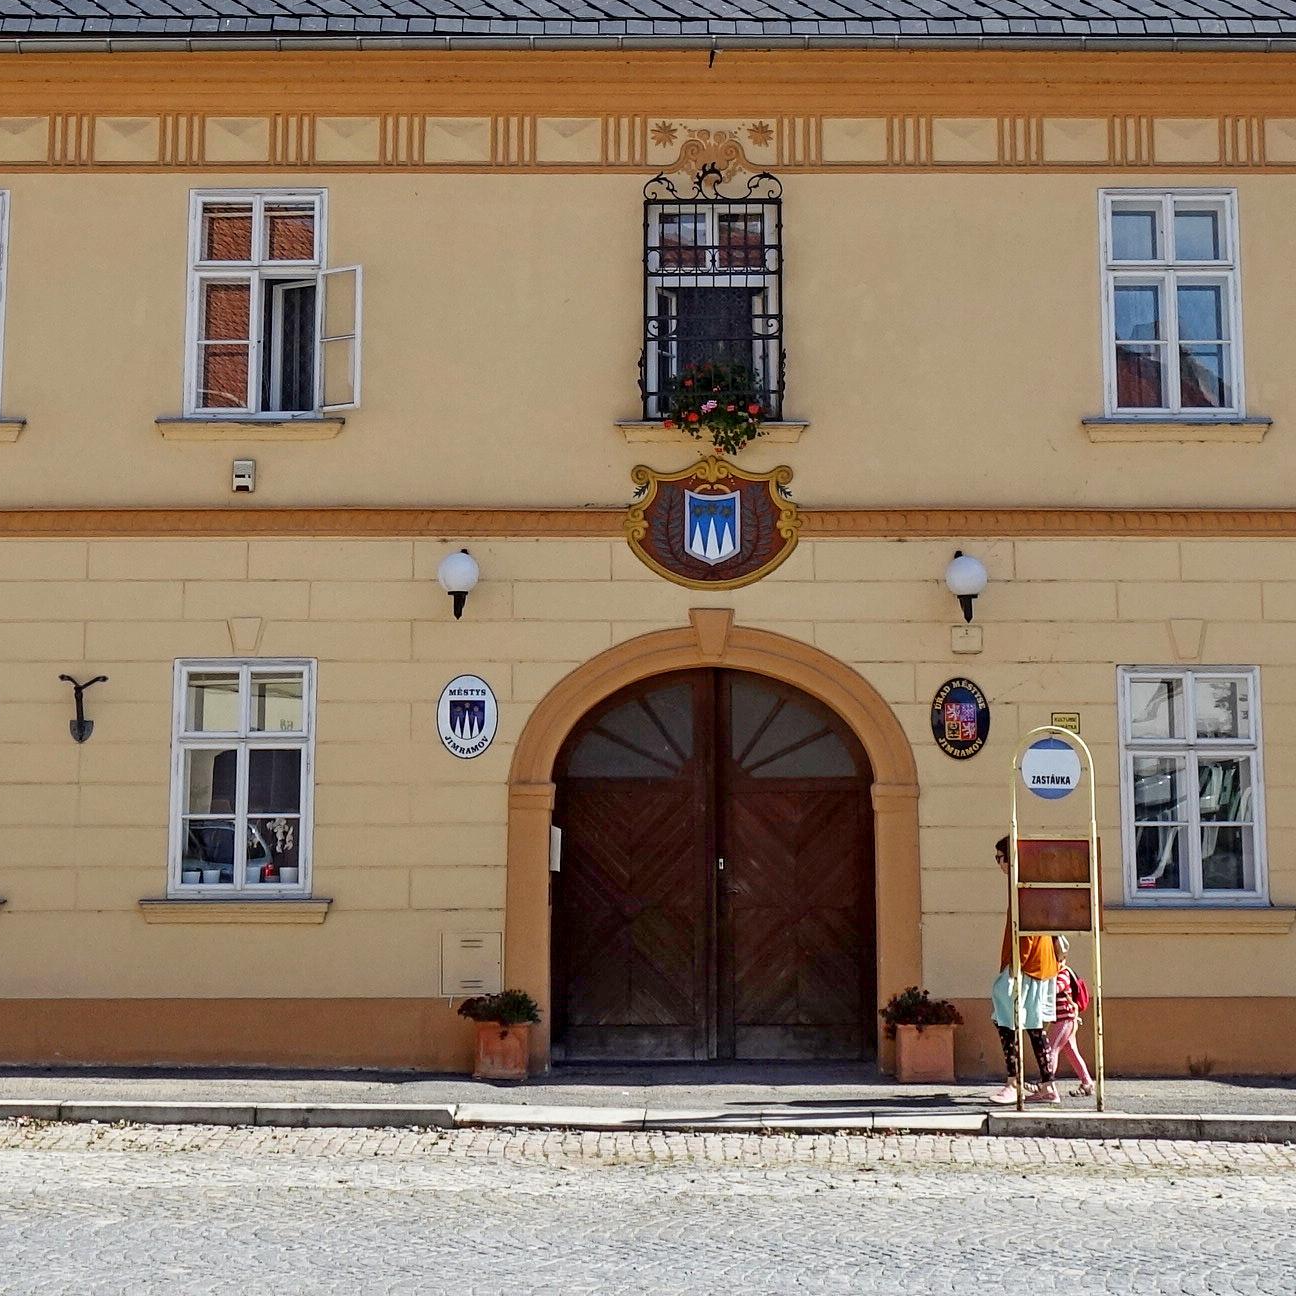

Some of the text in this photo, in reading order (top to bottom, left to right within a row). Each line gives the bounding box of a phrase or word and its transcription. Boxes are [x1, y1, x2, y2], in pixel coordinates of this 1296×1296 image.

[448, 687, 487, 696] MĚSTYS
[444, 735, 489, 755] JIMRAMOV
[938, 737, 983, 757] JIMRAMOV
[1031, 774, 1071, 785] ZASTÁVKA
